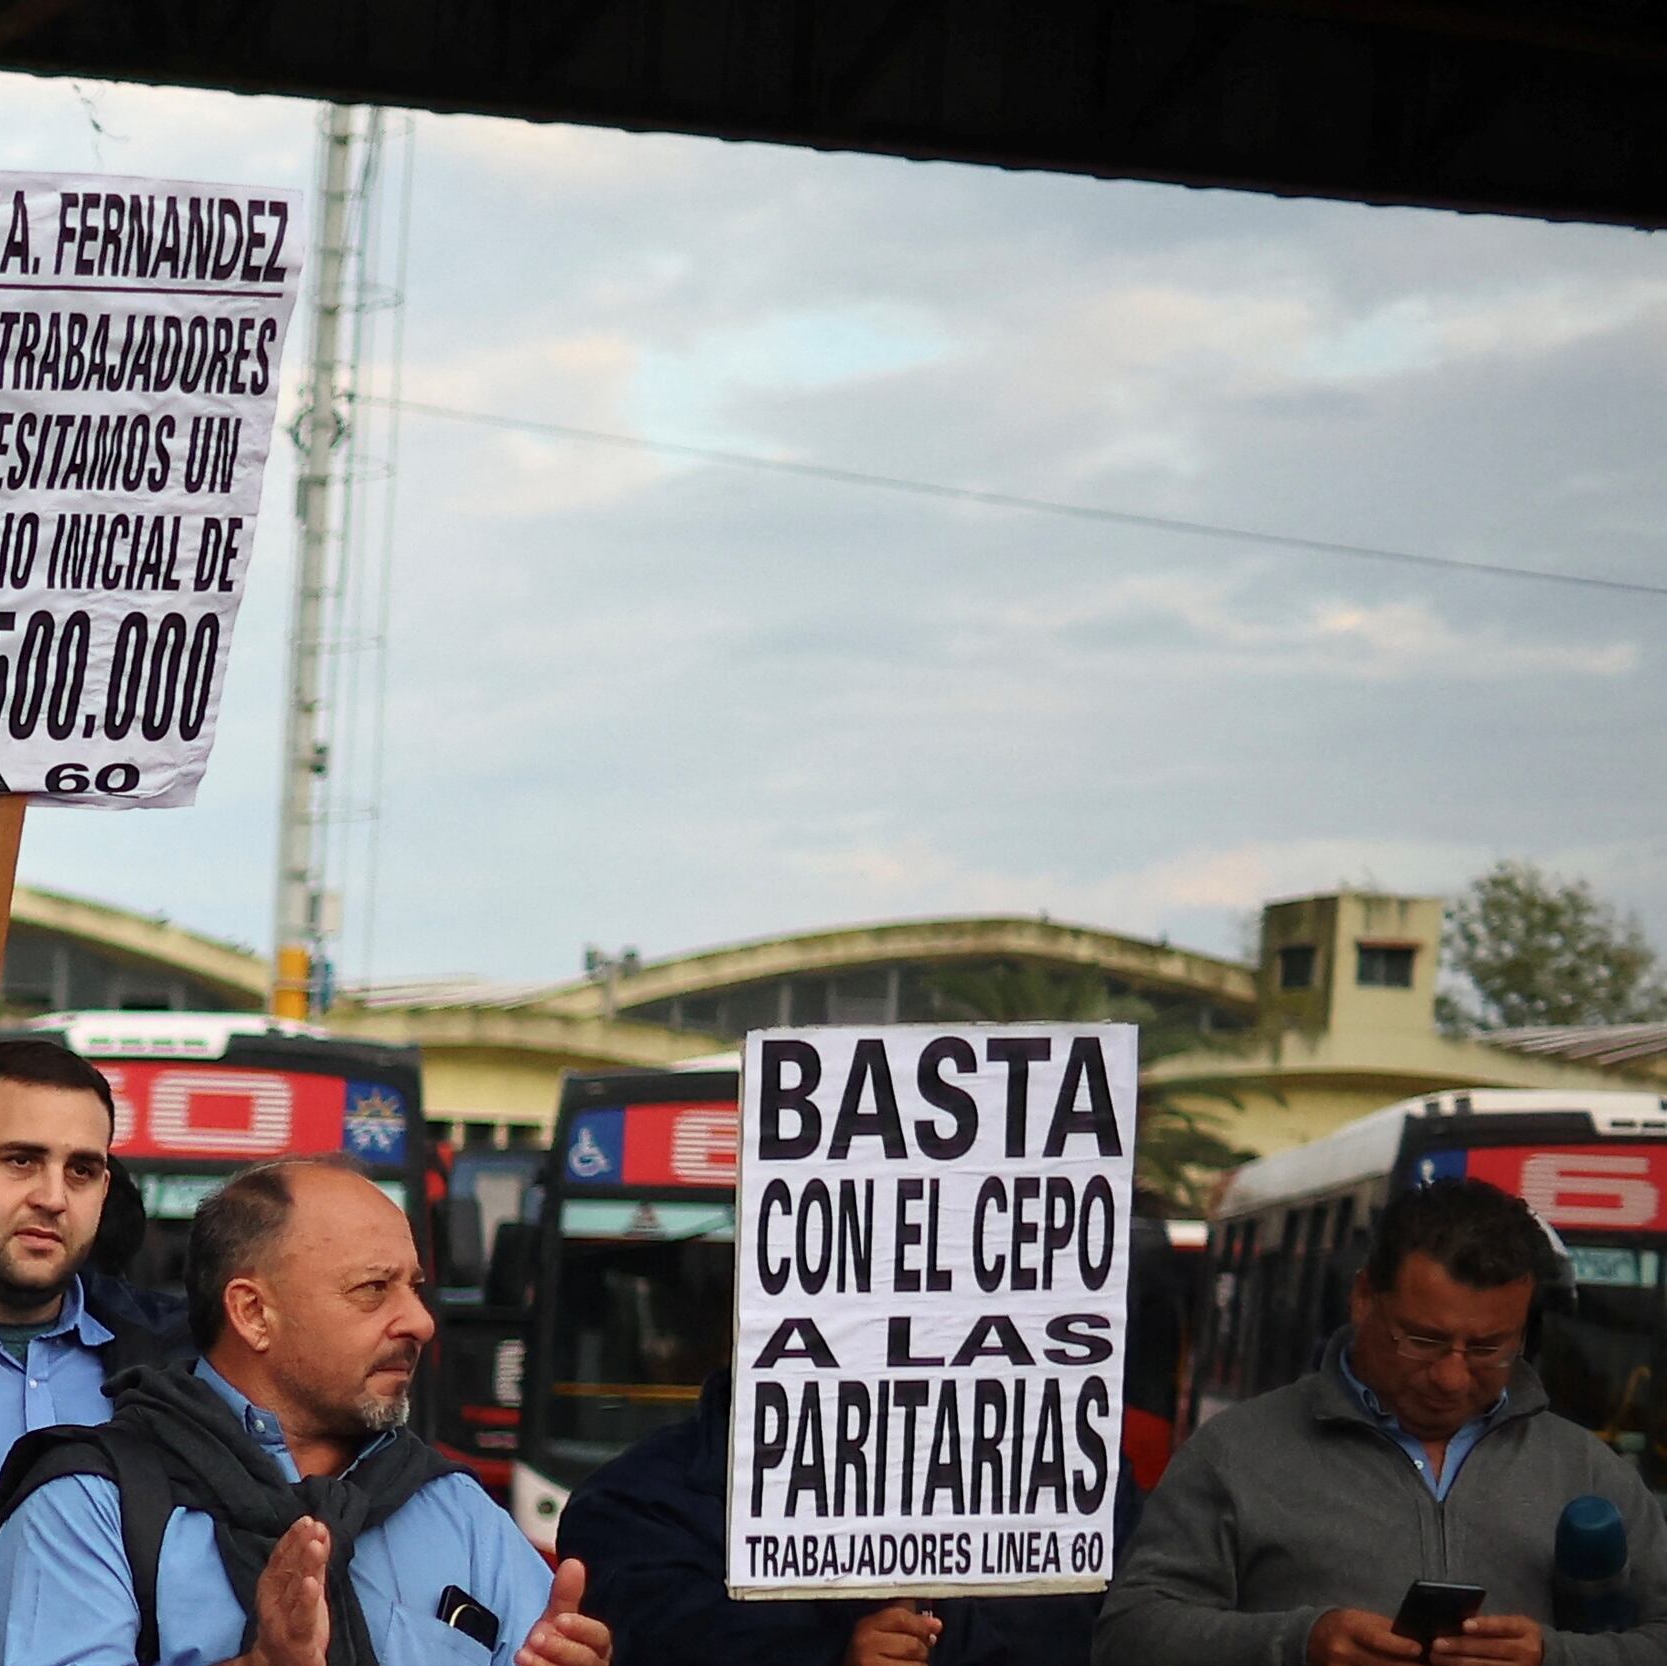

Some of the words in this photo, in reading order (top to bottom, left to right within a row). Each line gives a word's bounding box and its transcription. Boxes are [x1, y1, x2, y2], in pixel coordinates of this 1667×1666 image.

[54, 191, 289, 283] FERNANDEZ
[184, 417, 242, 494] UN
[47, 514, 181, 591] INICIAL
[193, 517, 243, 593] DE
[44, 761, 141, 794] 60
[758, 1036, 1123, 1160] BASTA
[757, 1177, 874, 1295] CON
[893, 1177, 952, 1292] EL
[972, 1175, 1115, 1292] CEPO
[751, 1317, 840, 1368] A
[886, 1314, 1114, 1367] LAS
[750, 1375, 1109, 1518] PARITARIAS
[745, 1532, 971, 1578] TRABAJADORES
[981, 1530, 1061, 1576] LINEA
[1071, 1532, 1104, 1573] 60
